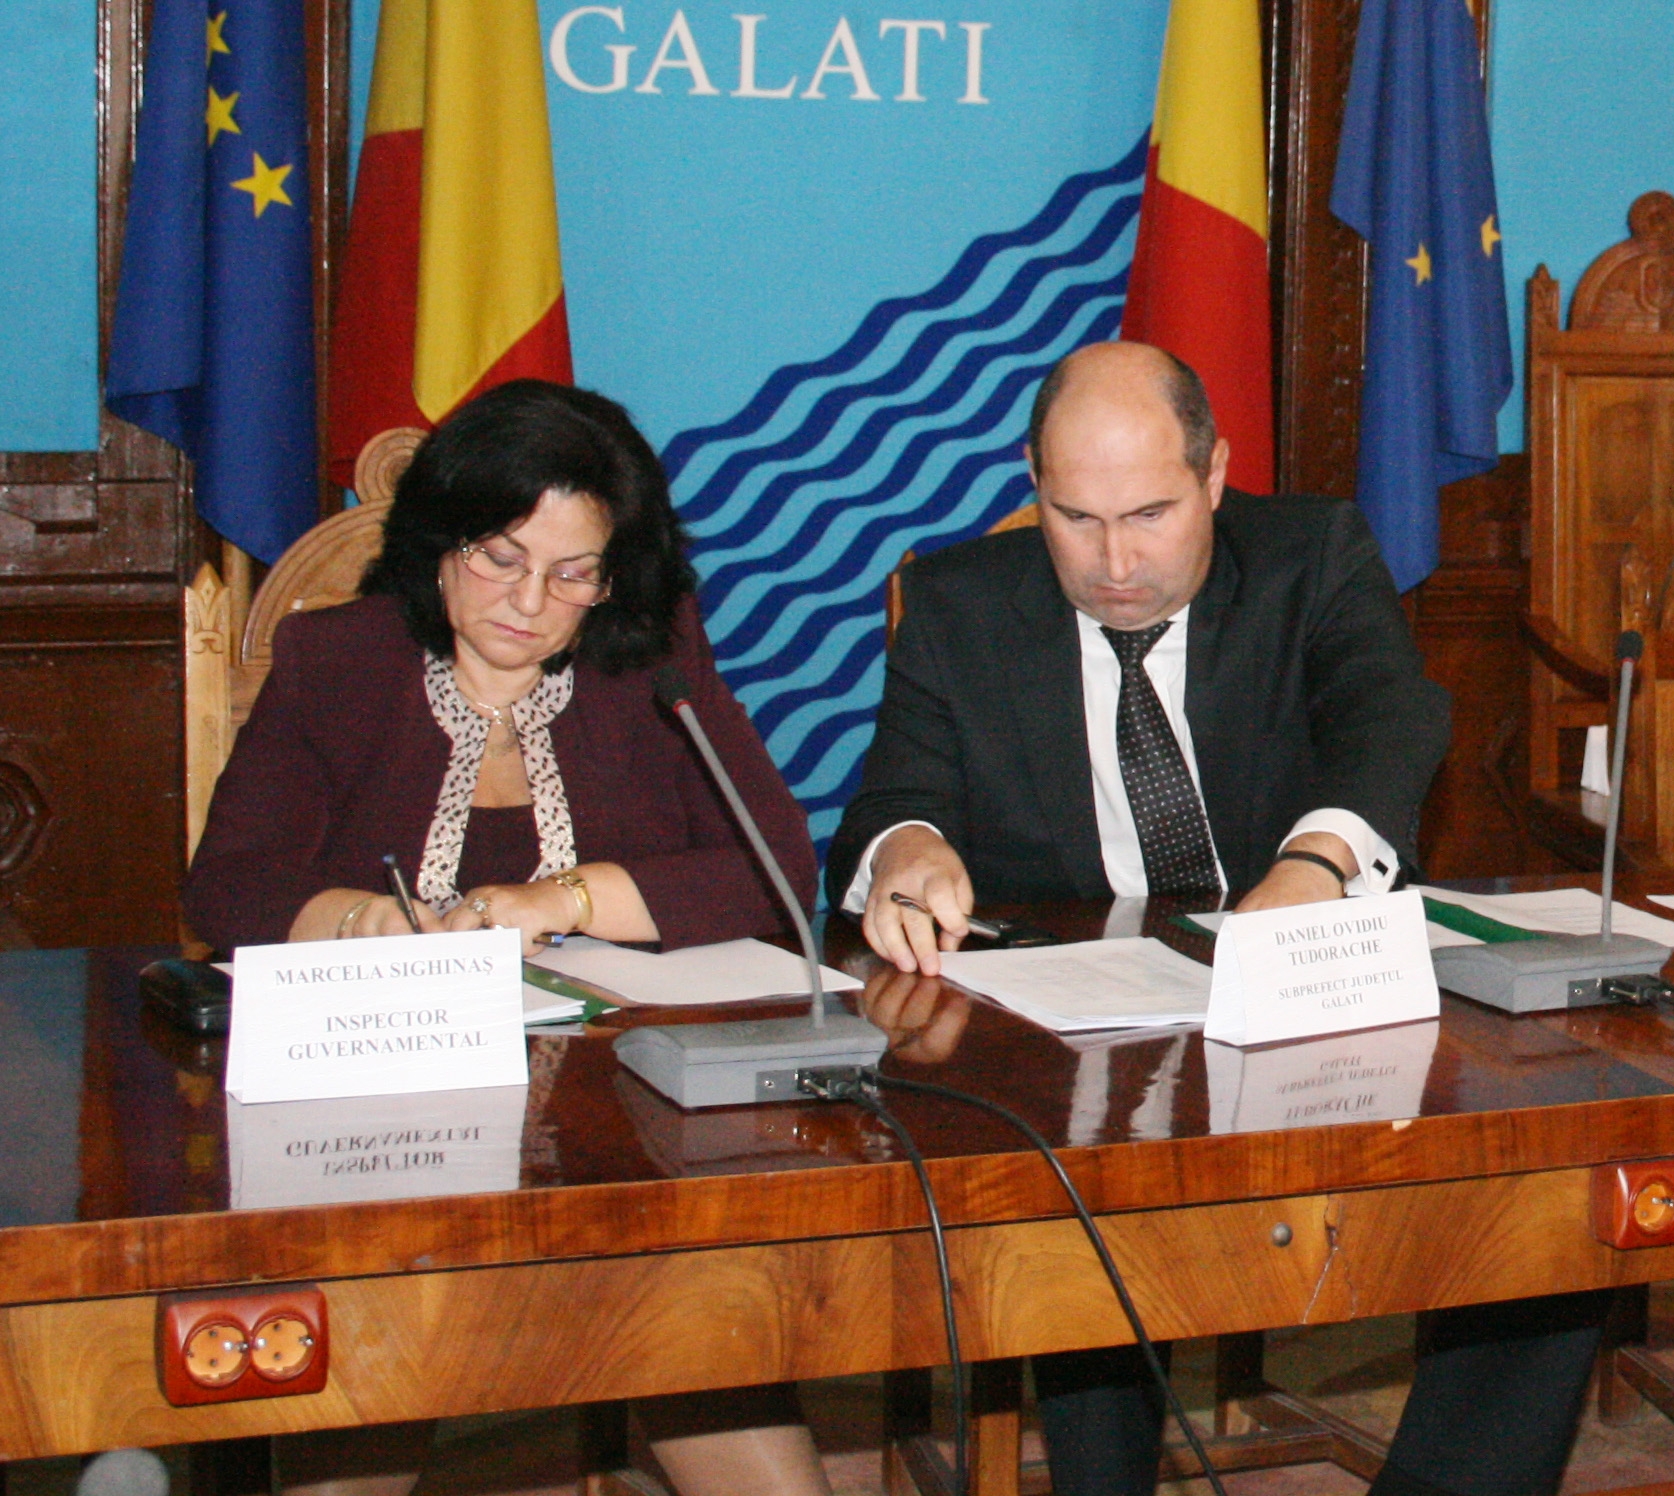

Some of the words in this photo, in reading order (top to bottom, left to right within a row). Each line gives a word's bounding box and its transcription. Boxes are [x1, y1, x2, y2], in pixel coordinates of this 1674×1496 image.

[549, 5, 992, 104] GALATI
[1274, 925, 1330, 946] DANIEL
[1333, 915, 1388, 937] OVIDIU
[1289, 938, 1383, 966] TUDORACHE
[274, 965, 384, 986] MARCELA
[1278, 979, 1347, 1000] SUBPREFECT
[1321, 993, 1364, 1010] GALATI
[326, 1009, 449, 1032] INSPECTOR
[288, 1031, 489, 1060] GUVERNAMENTAL
